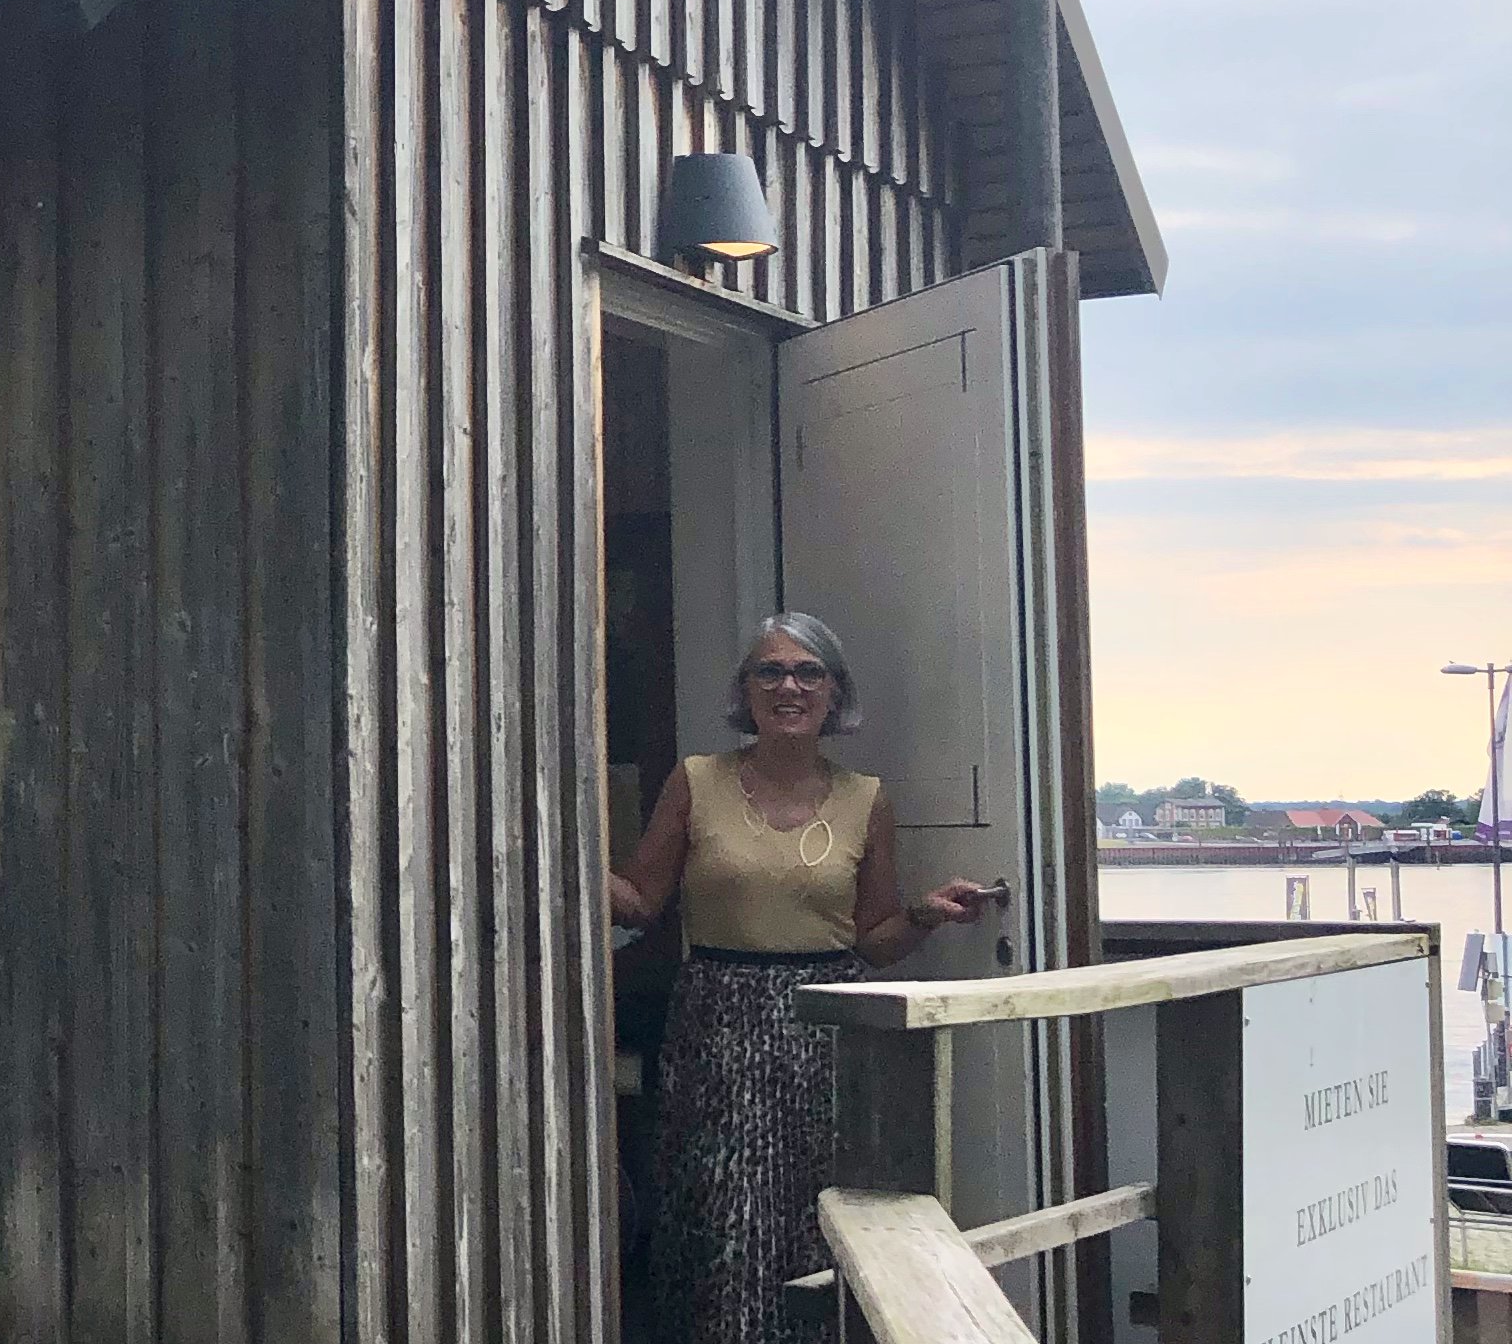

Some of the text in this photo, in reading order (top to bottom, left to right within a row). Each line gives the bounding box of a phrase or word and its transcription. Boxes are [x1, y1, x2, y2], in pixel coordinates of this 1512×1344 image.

[1303, 1070, 1389, 1131] MIETEN SIE
[1296, 1168, 1398, 1247] EXKLUSIV DAS
[1343, 1254, 1428, 1334] RESTAURANT
